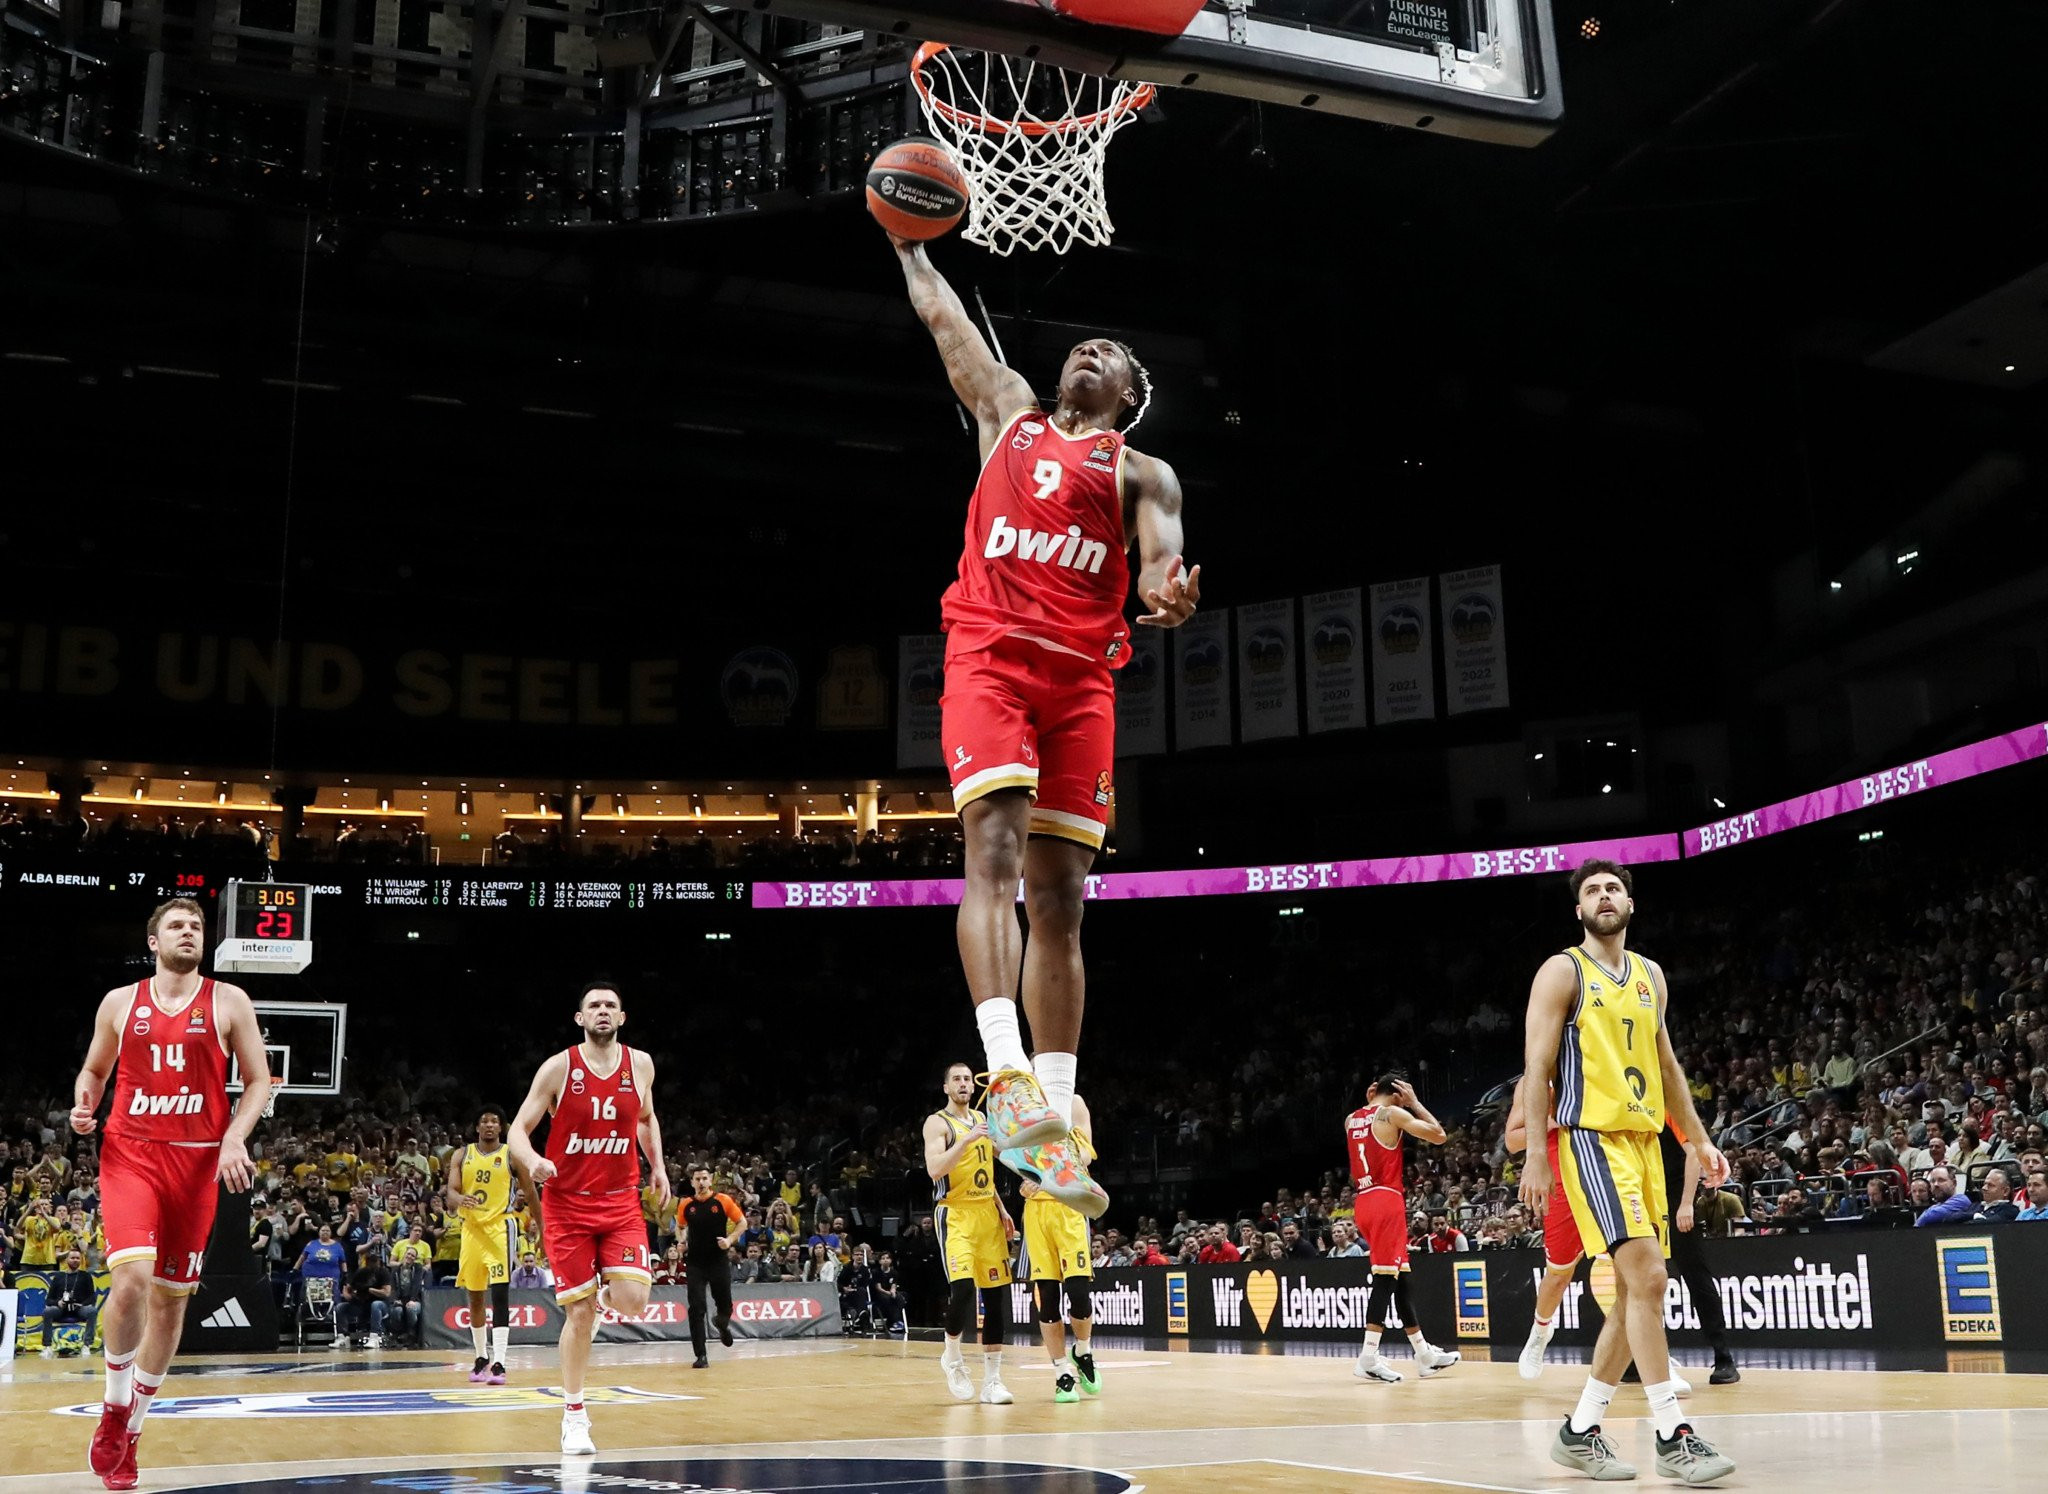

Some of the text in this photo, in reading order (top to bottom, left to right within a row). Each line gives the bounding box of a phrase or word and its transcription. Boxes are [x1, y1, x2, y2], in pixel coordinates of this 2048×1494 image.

[1389, 0, 1447, 19] TURKISH
[1388, 11, 1449, 32] AIRLINES
[1387, 23, 1451, 44] EuroLeague
[1033, 458, 1063, 500] 9
[983, 515, 1107, 574] bwin
[0, 623, 678, 726] IB UND SEELE
[1461, 668, 1492, 682] 2022
[1388, 679, 1418, 692] 2021
[1322, 688, 1350, 702] 2020
[20, 873, 100, 886] ALBA BERLIN
[128, 873, 145, 885] 37
[384, 880, 428, 888] WILLIAMS-
[441, 880, 452, 888] 15
[555, 882, 565, 890] 14
[577, 882, 621, 891] VEZENKOV
[637, 883, 646, 891] 11
[386, 888, 421, 896] WRIGHT
[481, 890, 496, 898] LEE
[652, 883, 664, 891] 25
[676, 883, 708, 891] PETERS
[734, 883, 744, 891] 12
[458, 897, 468, 905] 12
[481, 899, 507, 907] EVANS
[652, 891, 663, 899] 77
[676, 891, 715, 899] MCKISSIC
[554, 899, 565, 908] 22
[576, 900, 611, 908] DORSEY
[256, 912, 293, 938] 23
[242, 941, 293, 953] interzero
[1621, 1018, 1634, 1051] 7
[150, 1043, 186, 1073] 14
[128, 1085, 204, 1116] bwin
[591, 1096, 617, 1120] 16
[565, 1130, 630, 1155] bwin
[975, 1144, 987, 1163] 11
[1358, 1143, 1370, 1175] 1
[476, 1169, 491, 1184] 33
[1076, 1251, 1086, 1269] 6
[1010, 1282, 1033, 1324] Wir
[1212, 1273, 1404, 1329] Wir Lebensm
[1170, 1320, 1186, 1328] EDEKA
[1459, 1322, 1487, 1332] EDEKA
[1949, 1321, 1996, 1333] EDEKA
